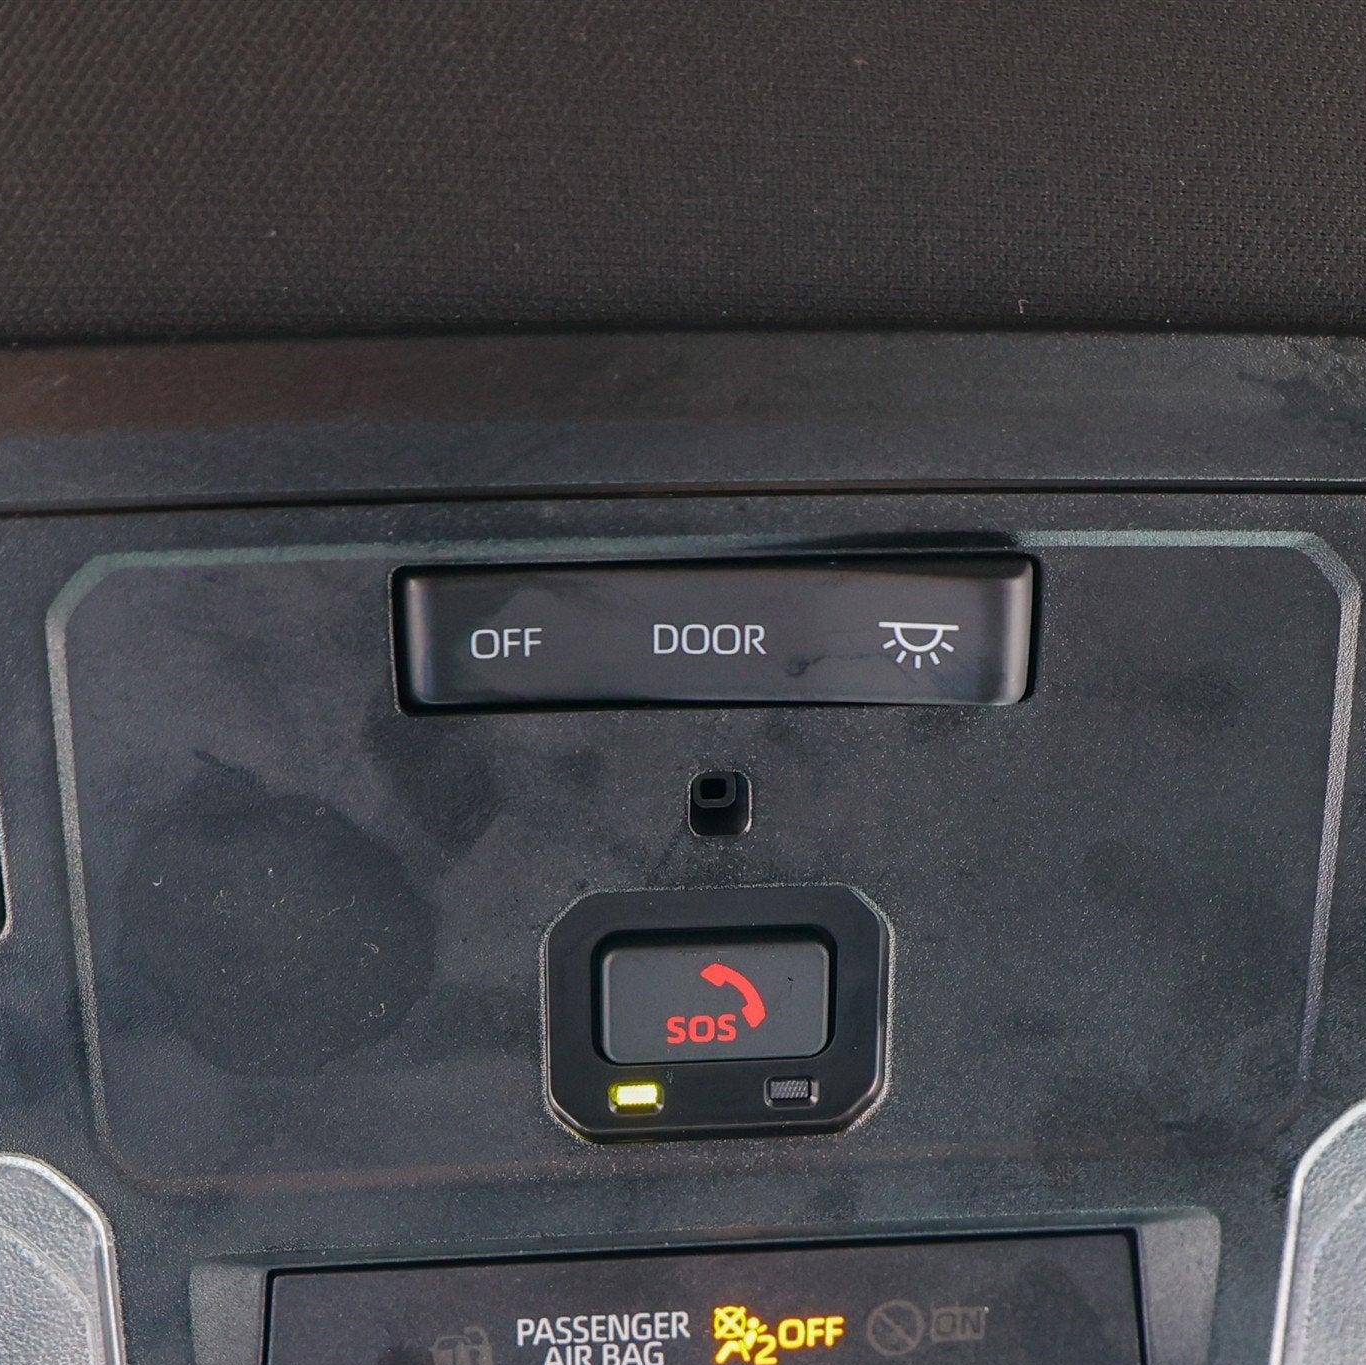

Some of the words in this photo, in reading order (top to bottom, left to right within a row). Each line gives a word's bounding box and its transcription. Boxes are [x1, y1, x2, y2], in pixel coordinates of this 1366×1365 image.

[470, 627, 542, 660] OFF
[652, 623, 767, 656] DOOR
[666, 1013, 737, 1044] SOS
[516, 1311, 691, 1347] PASSENGER
[777, 1315, 845, 1349] OFF
